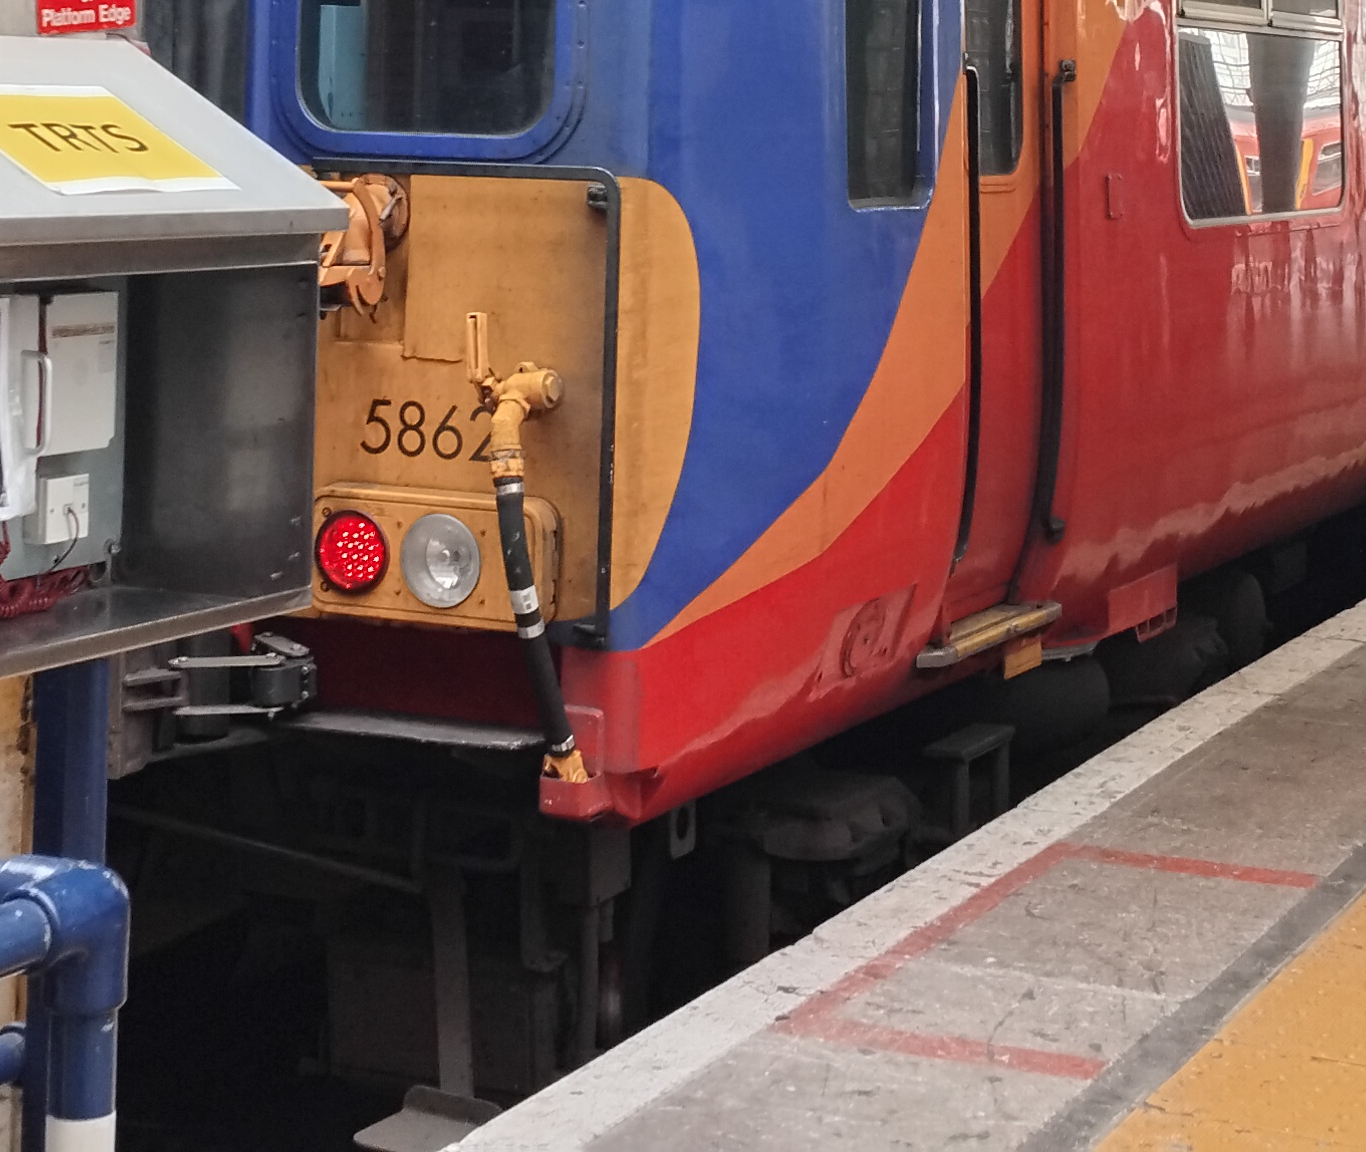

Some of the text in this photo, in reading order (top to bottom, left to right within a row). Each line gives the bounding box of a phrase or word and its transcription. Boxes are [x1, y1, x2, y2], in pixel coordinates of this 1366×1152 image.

[41, 3, 132, 27] Platform Edge
[7, 122, 149, 154] TRTS
[360, 399, 491, 462] 5862
